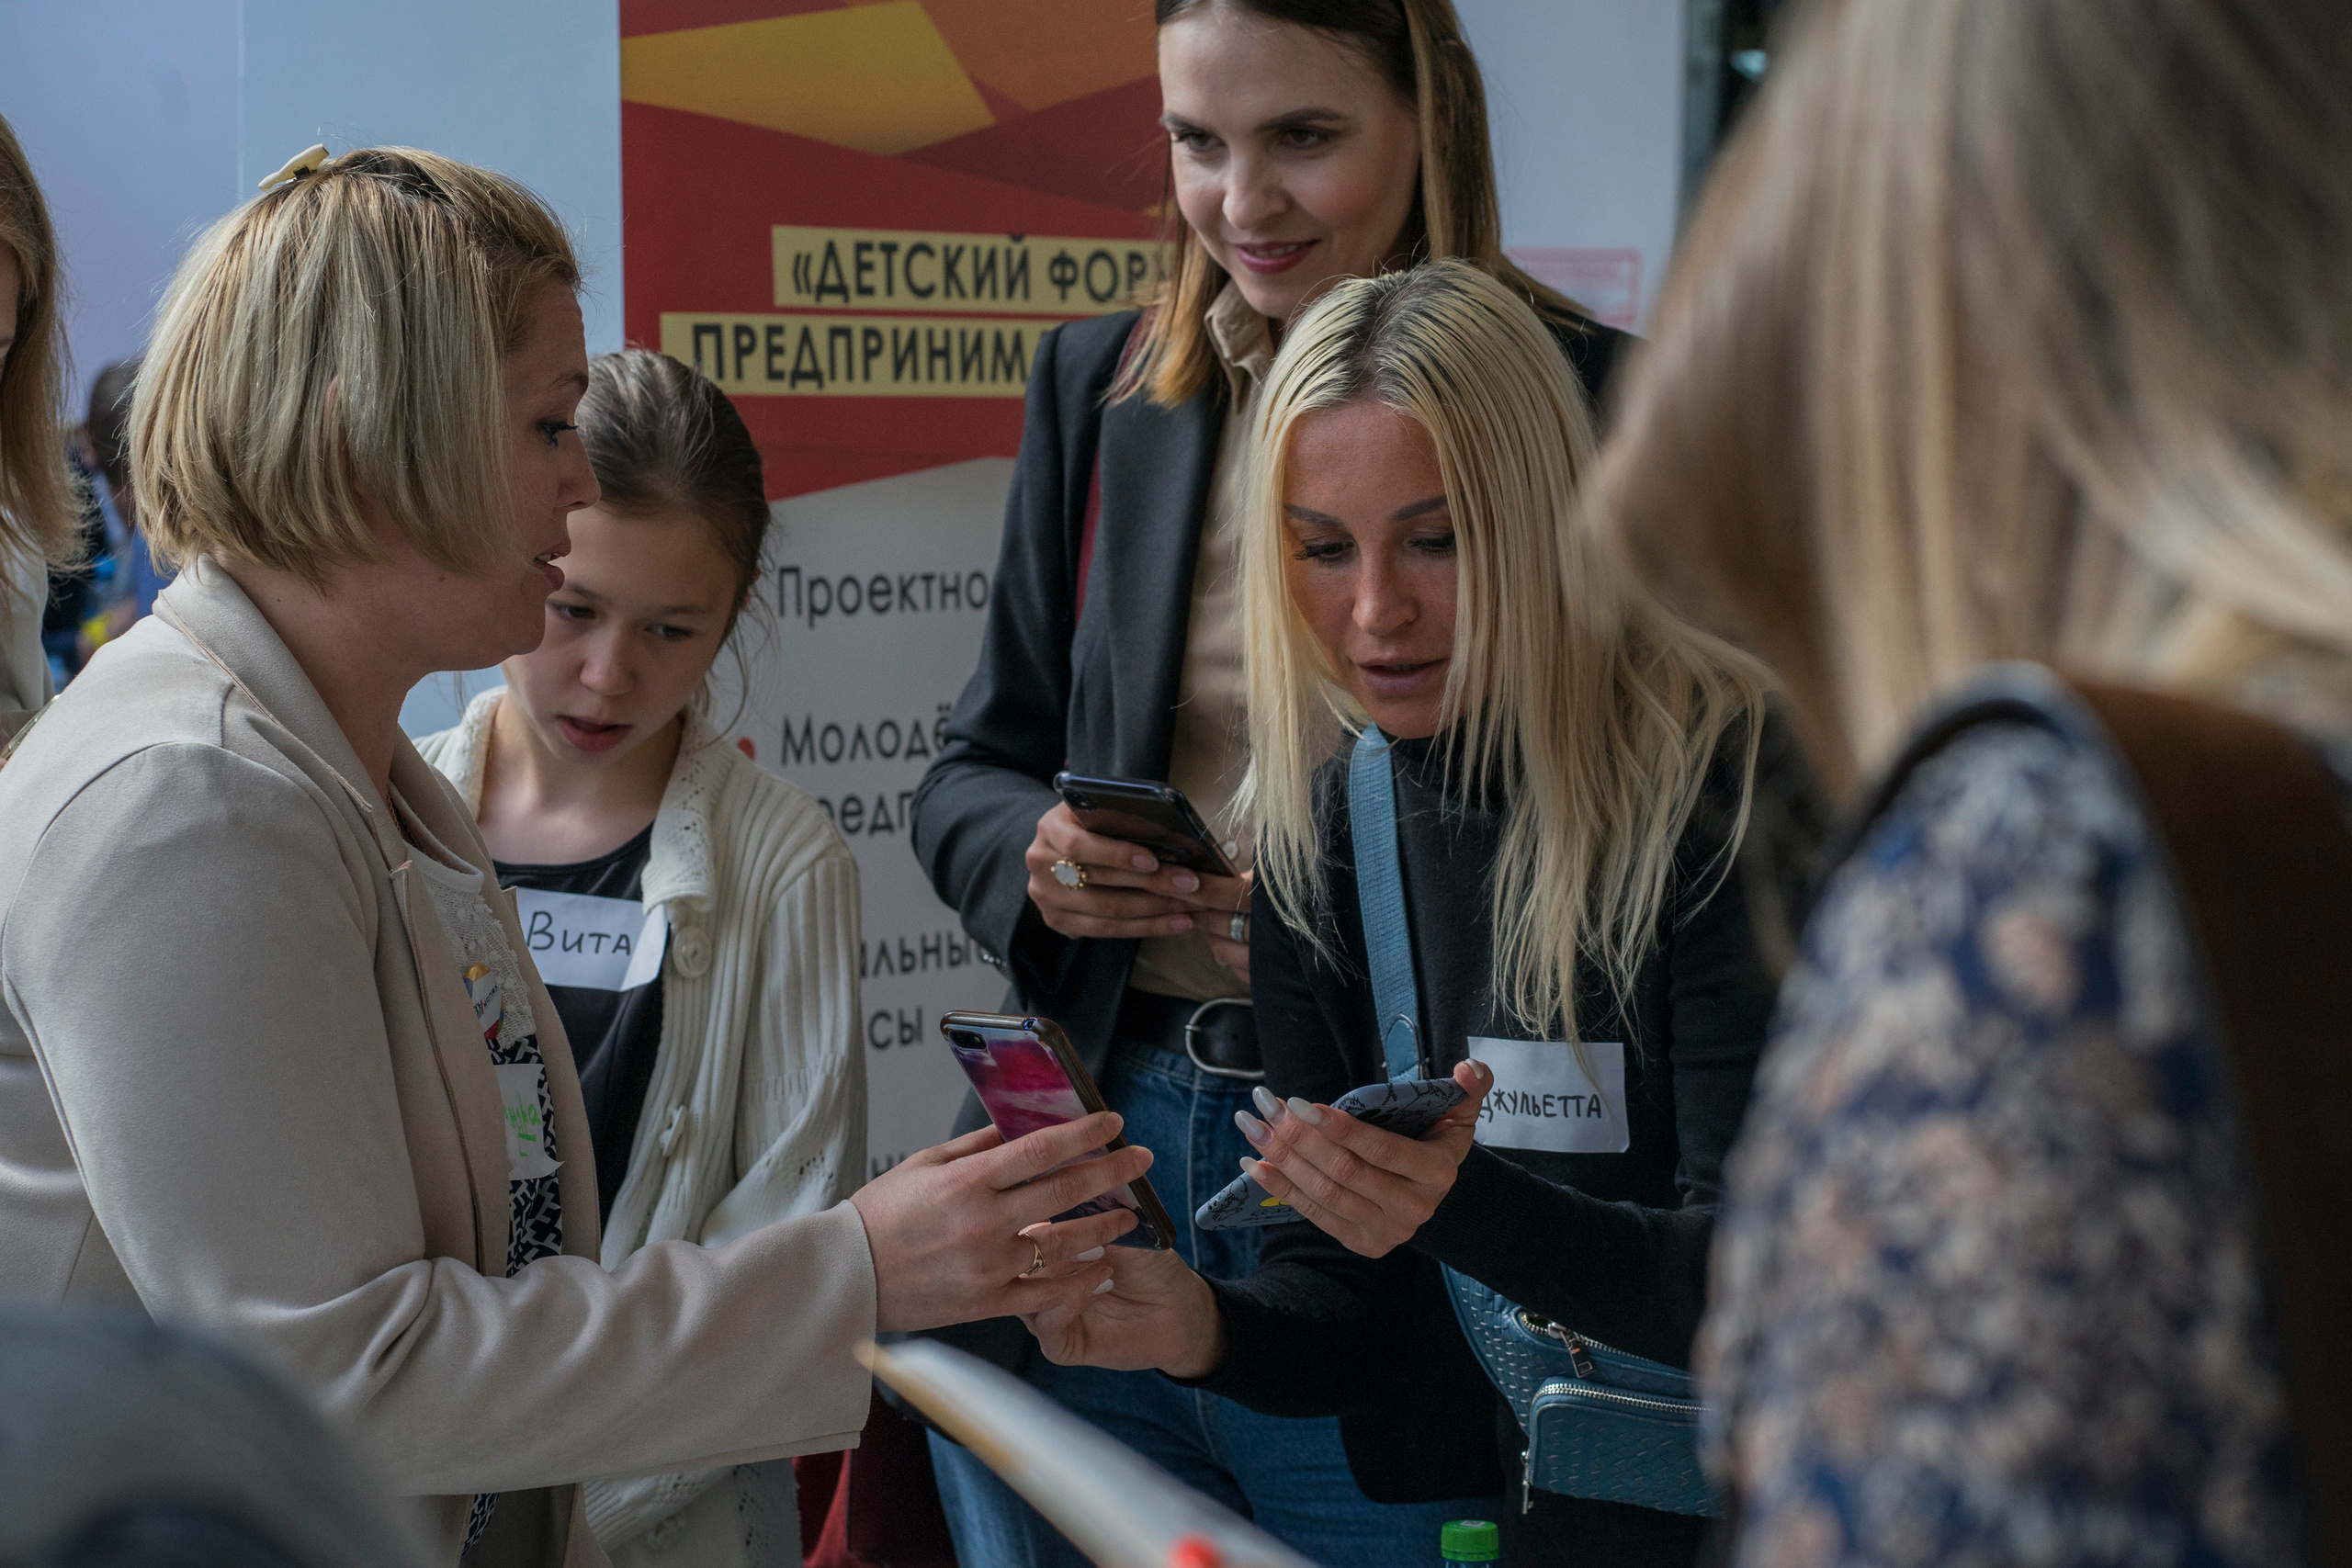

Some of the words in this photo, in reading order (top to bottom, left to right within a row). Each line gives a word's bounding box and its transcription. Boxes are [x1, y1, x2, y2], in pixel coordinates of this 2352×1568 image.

[791, 235, 1031, 303] «ДЕТСКИЙ
[691, 322, 1046, 389] ПРЕДПРИНИМ
[778, 566, 989, 629] Проектно
